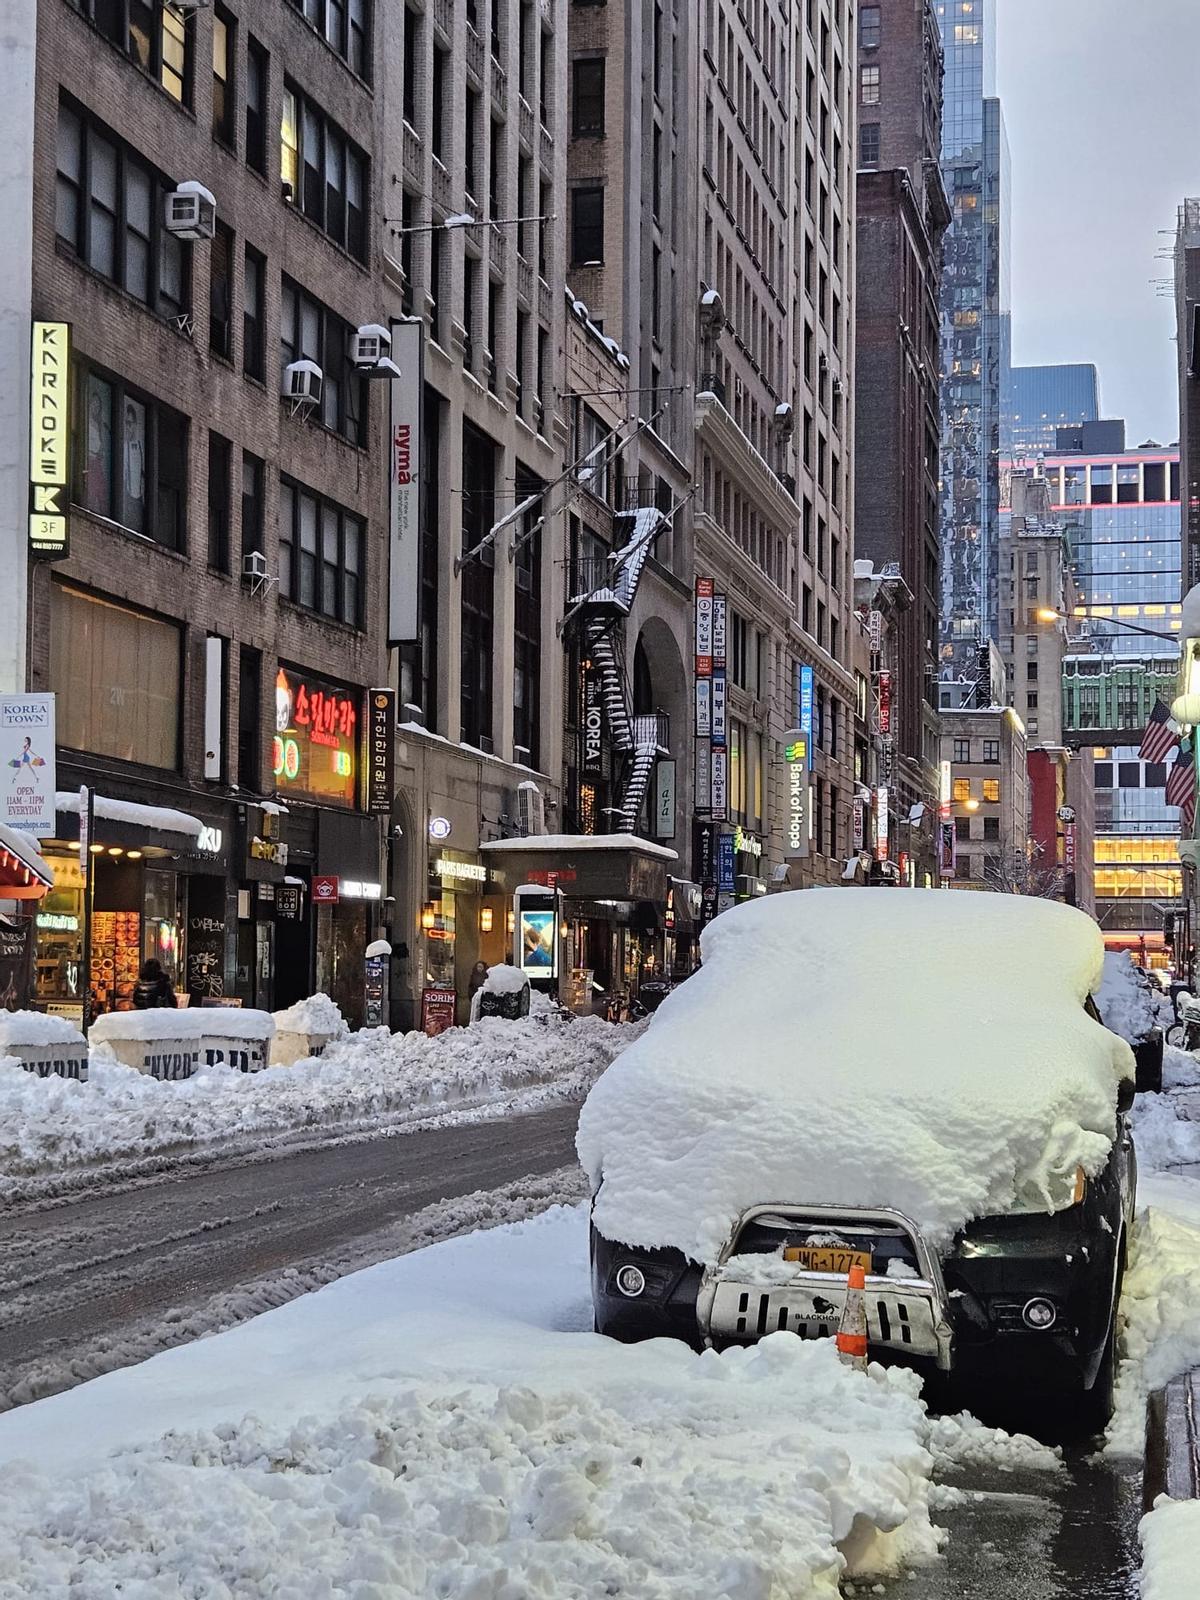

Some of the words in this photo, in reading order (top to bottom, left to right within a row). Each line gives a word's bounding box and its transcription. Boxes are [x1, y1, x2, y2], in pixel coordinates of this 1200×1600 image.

[395, 424, 411, 485] nyma
[34, 486, 61, 512] K
[41, 521, 56, 533] 3F
[587, 682, 597, 704] miss
[801, 687, 811, 708] THE
[4, 705, 47, 714] KOREA
[714, 682, 723, 727] 피부과
[7, 714, 44, 723] TOWN
[880, 710, 889, 733] BAR
[586, 707, 600, 760] KOREA
[16, 787, 35, 795] OPEN
[790, 764, 803, 797] Bank
[29, 796, 44, 804] 11PM
[790, 798, 802, 813] of
[8, 806, 42, 816] EVERYDAY
[788, 814, 802, 849] Hope
[724, 845, 733, 881] 한의원
[425, 993, 455, 1003] SORIM
